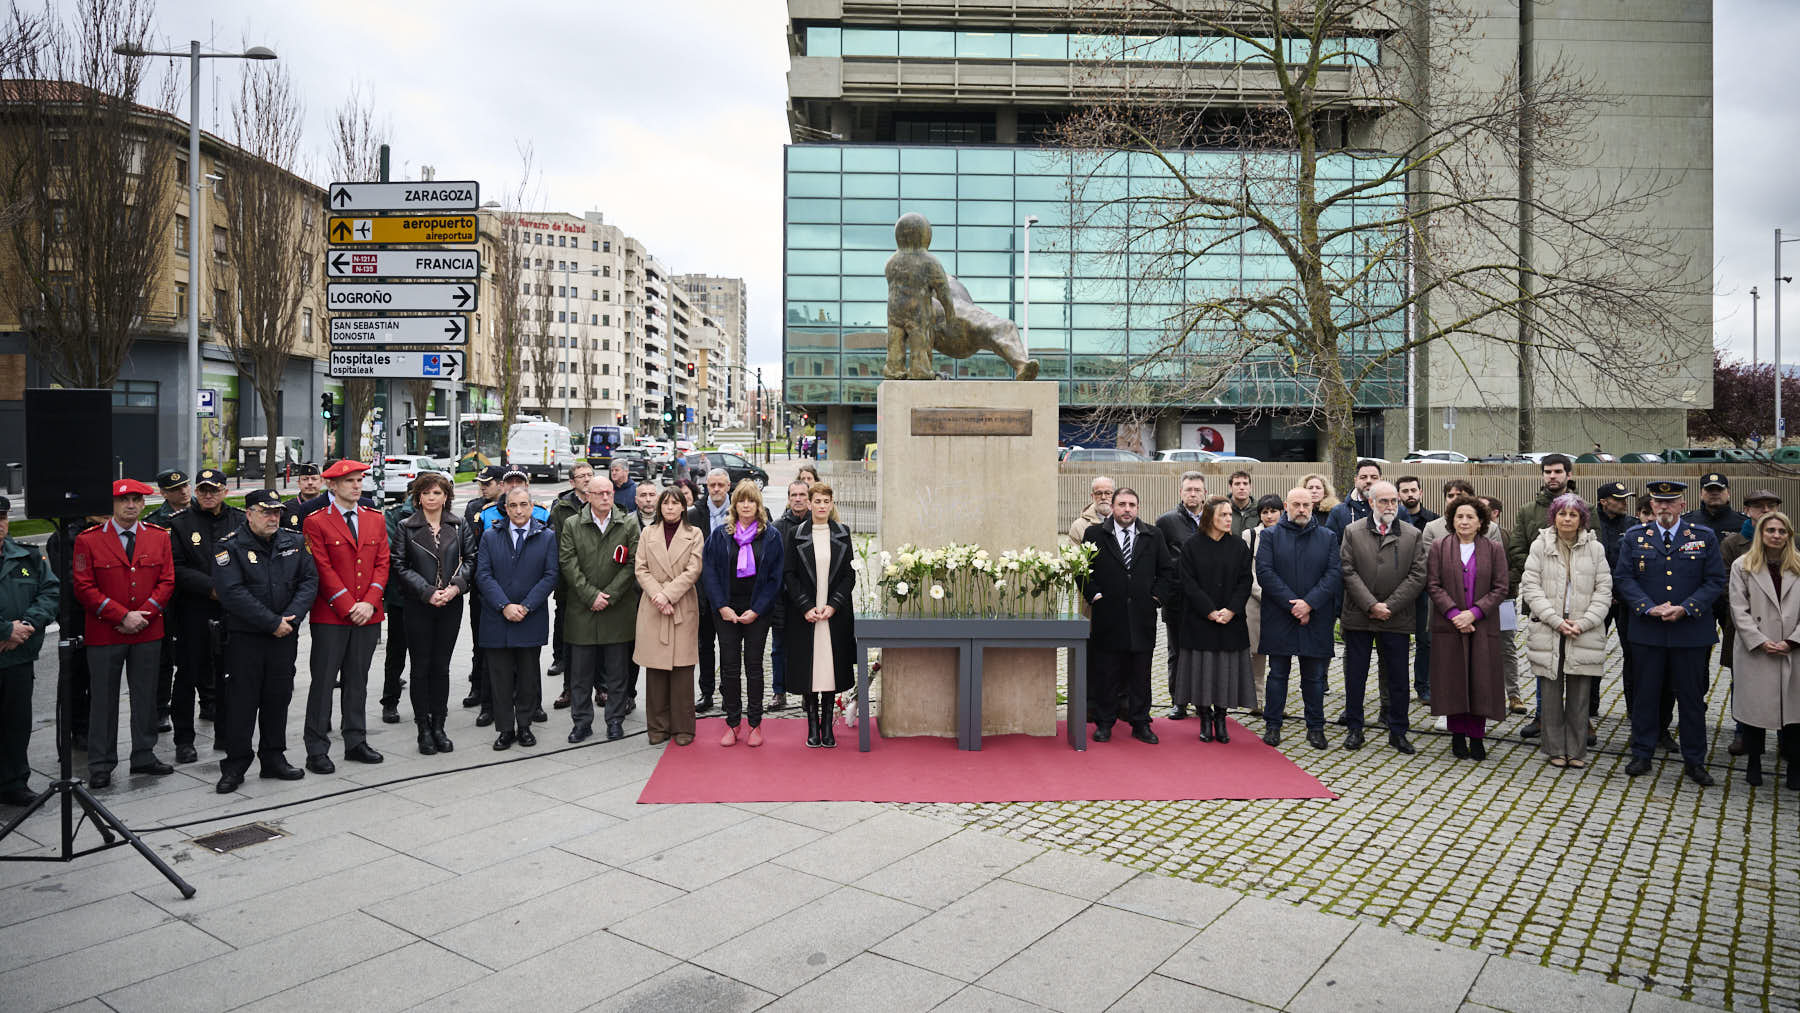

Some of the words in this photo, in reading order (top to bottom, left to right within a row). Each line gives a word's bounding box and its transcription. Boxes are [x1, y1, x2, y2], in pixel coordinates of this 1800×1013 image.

[405, 190, 473, 201] ZARAGOZA
[403, 217, 473, 231] aeropuerto
[552, 222, 562, 231] de
[425, 231, 473, 242] aireportua
[416, 258, 474, 270] FRANCIA
[330, 290, 392, 304] LOGROÑO
[334, 322, 351, 330] SAN
[333, 332, 376, 341] DONOSTIA
[333, 353, 391, 368] hospitales
[333, 366, 374, 375] ospitaleak
[198, 392, 211, 407] P
